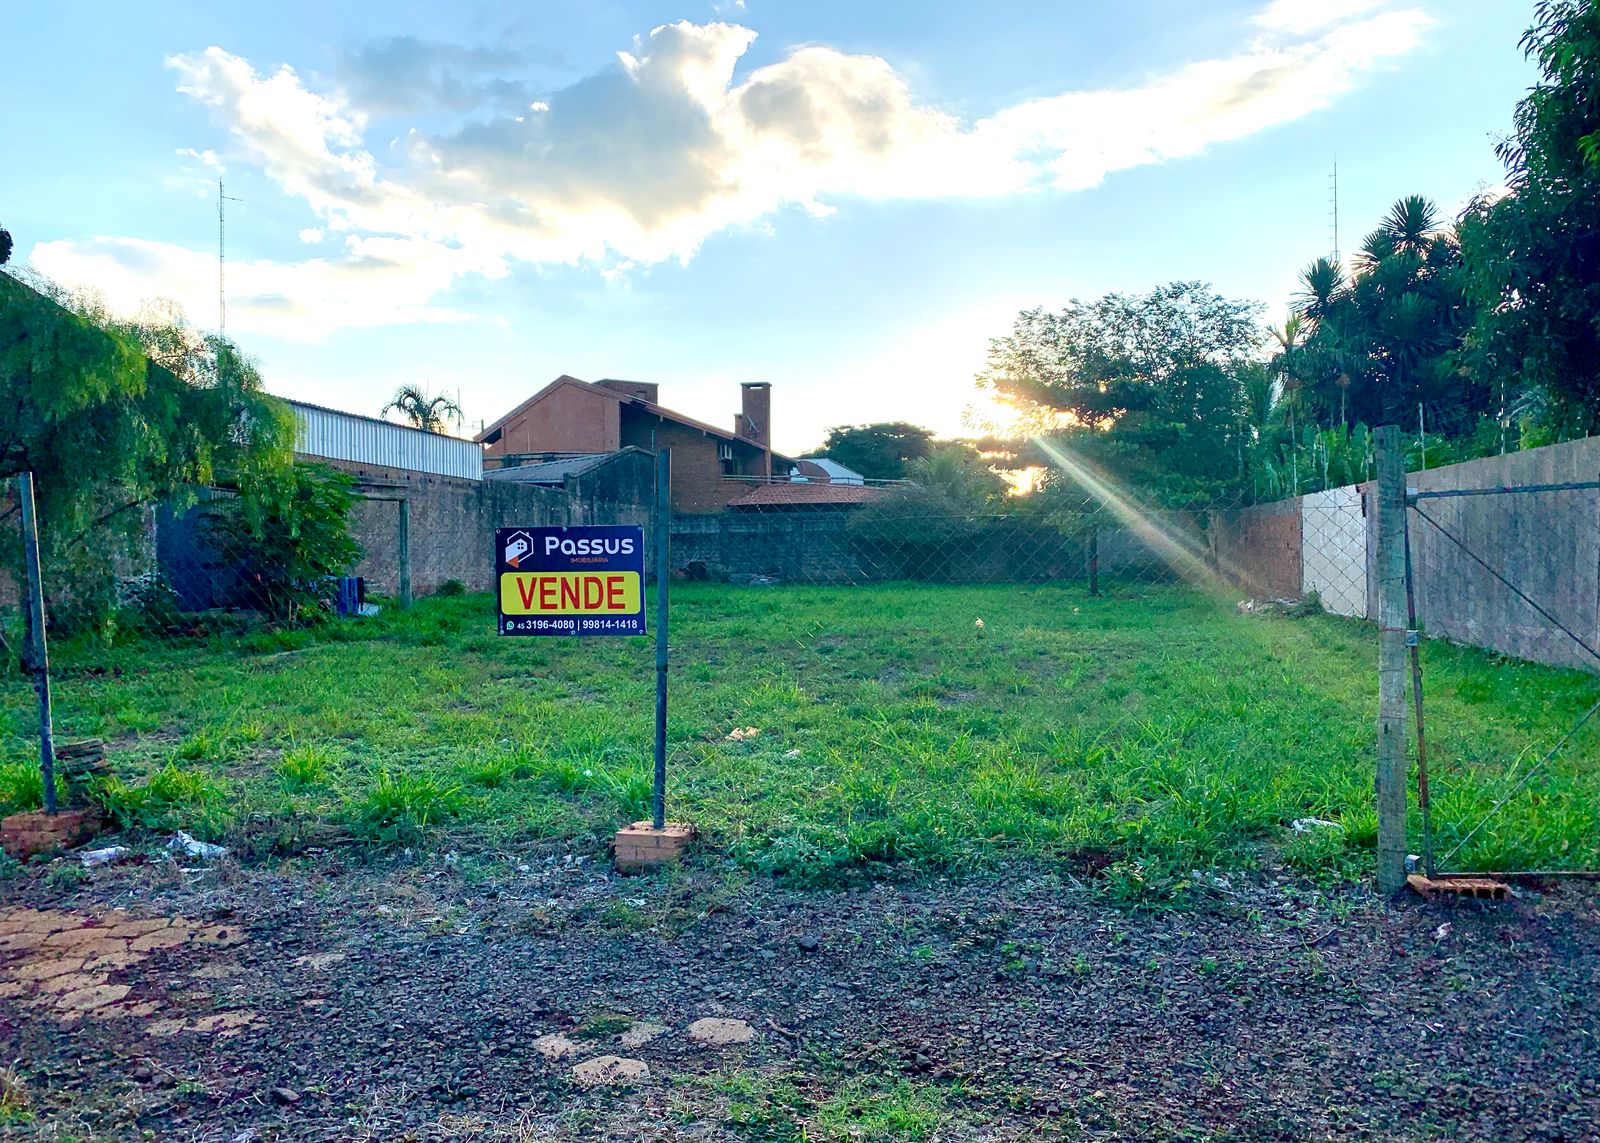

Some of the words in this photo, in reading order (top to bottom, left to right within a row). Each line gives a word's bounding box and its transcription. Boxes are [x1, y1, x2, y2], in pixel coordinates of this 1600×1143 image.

[545, 536, 634, 555] Passus
[516, 576, 626, 610] VENDE
[526, 620, 575, 629] 3196-4080
[582, 620, 638, 629] 99814-1418
